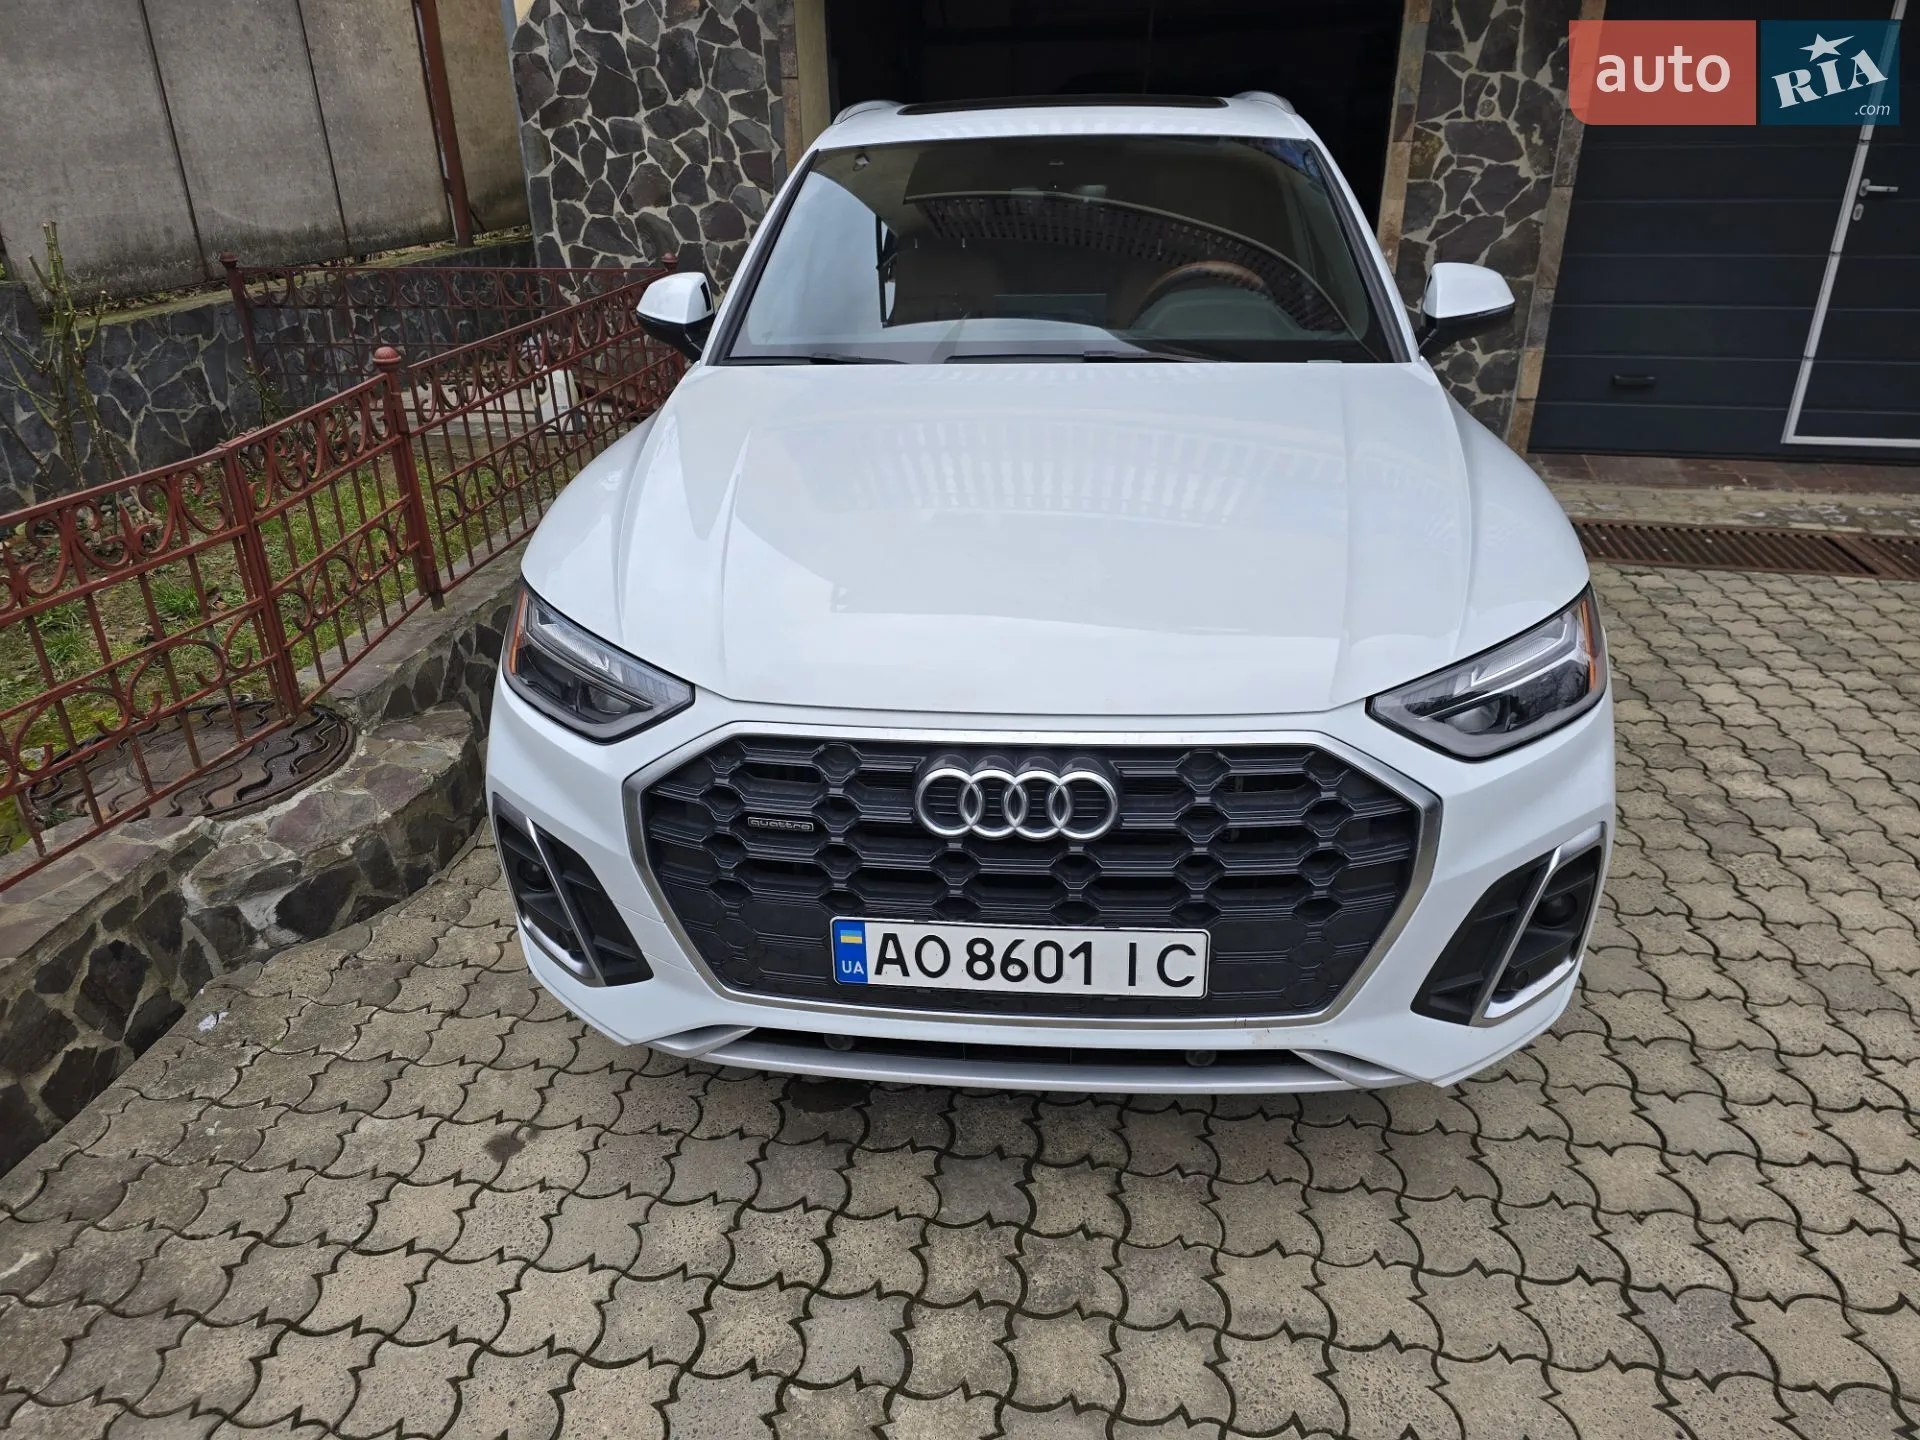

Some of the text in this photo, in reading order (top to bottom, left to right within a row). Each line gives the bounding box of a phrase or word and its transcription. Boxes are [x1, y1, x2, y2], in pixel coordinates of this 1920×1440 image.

[750, 819, 811, 830] quattro
[841, 959, 865, 976] UA
[874, 932, 1197, 988] AO 8601 IC
